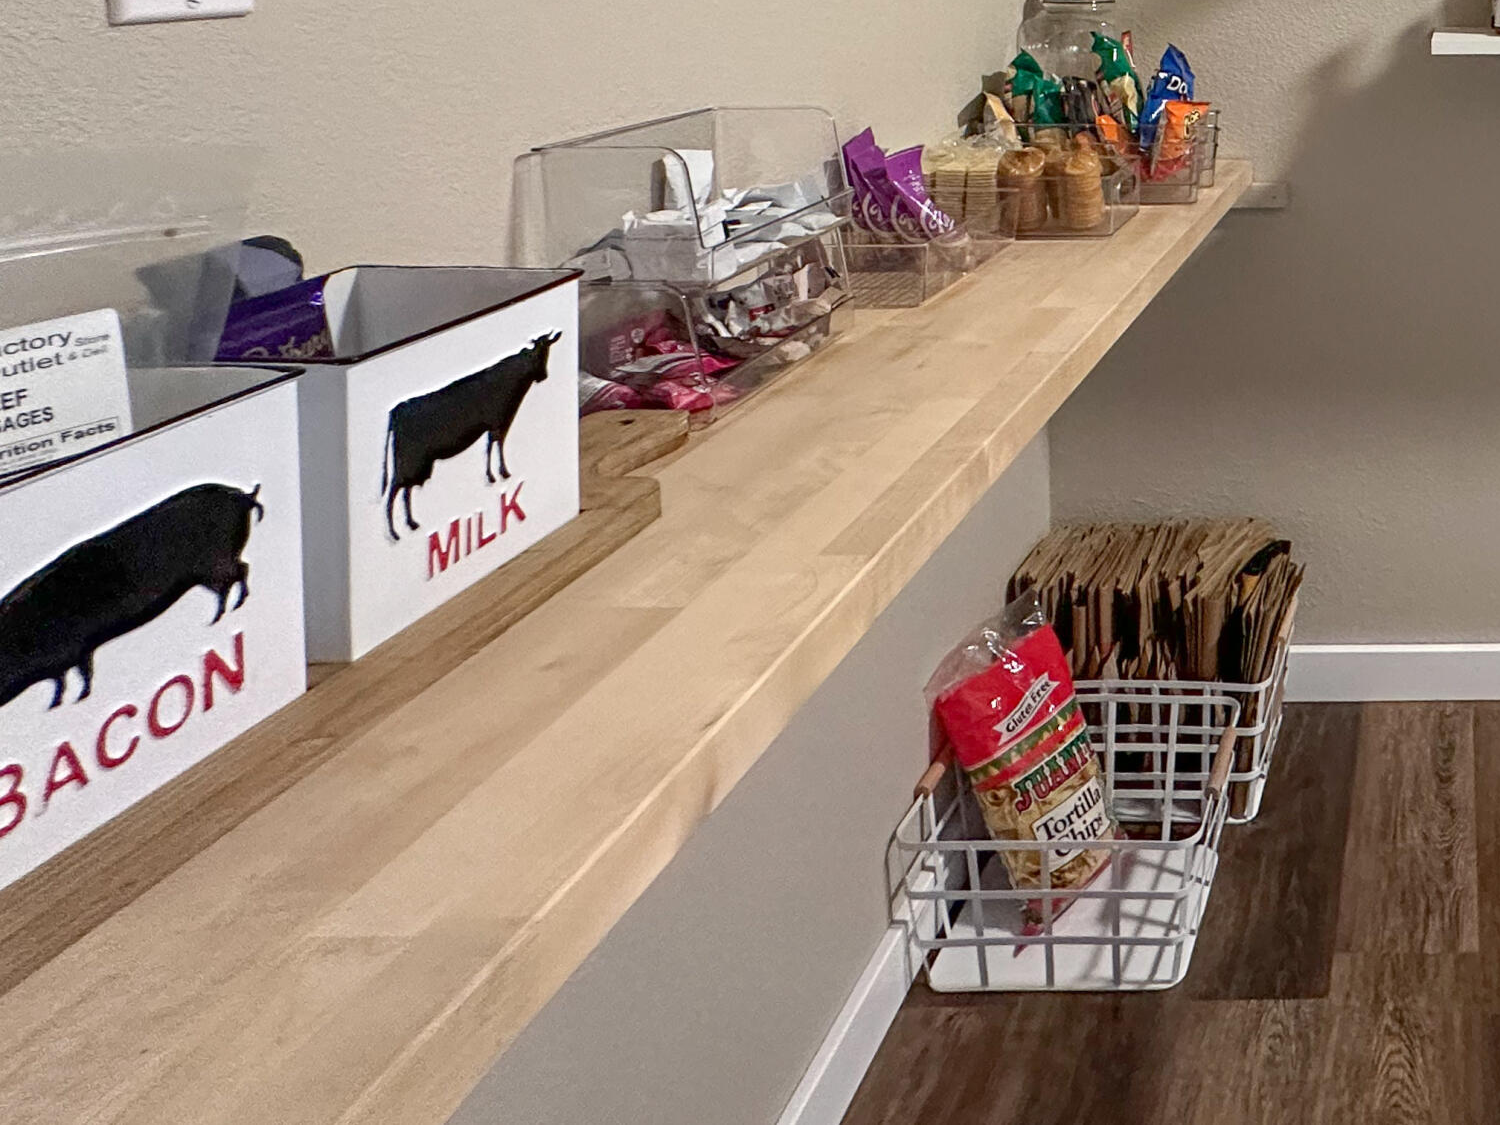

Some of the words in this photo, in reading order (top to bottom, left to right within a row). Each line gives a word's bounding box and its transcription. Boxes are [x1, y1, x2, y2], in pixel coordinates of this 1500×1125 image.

[0, 331, 73, 357] ctory
[1, 352, 65, 378] utlet
[0, 438, 54, 460] rition
[60, 422, 117, 443] Facts
[427, 480, 528, 581] MILK
[1005, 703, 1034, 735] Gluten
[1030, 680, 1051, 705] Free
[0, 631, 246, 839] BACON
[1035, 786, 1101, 839] Tortilla
